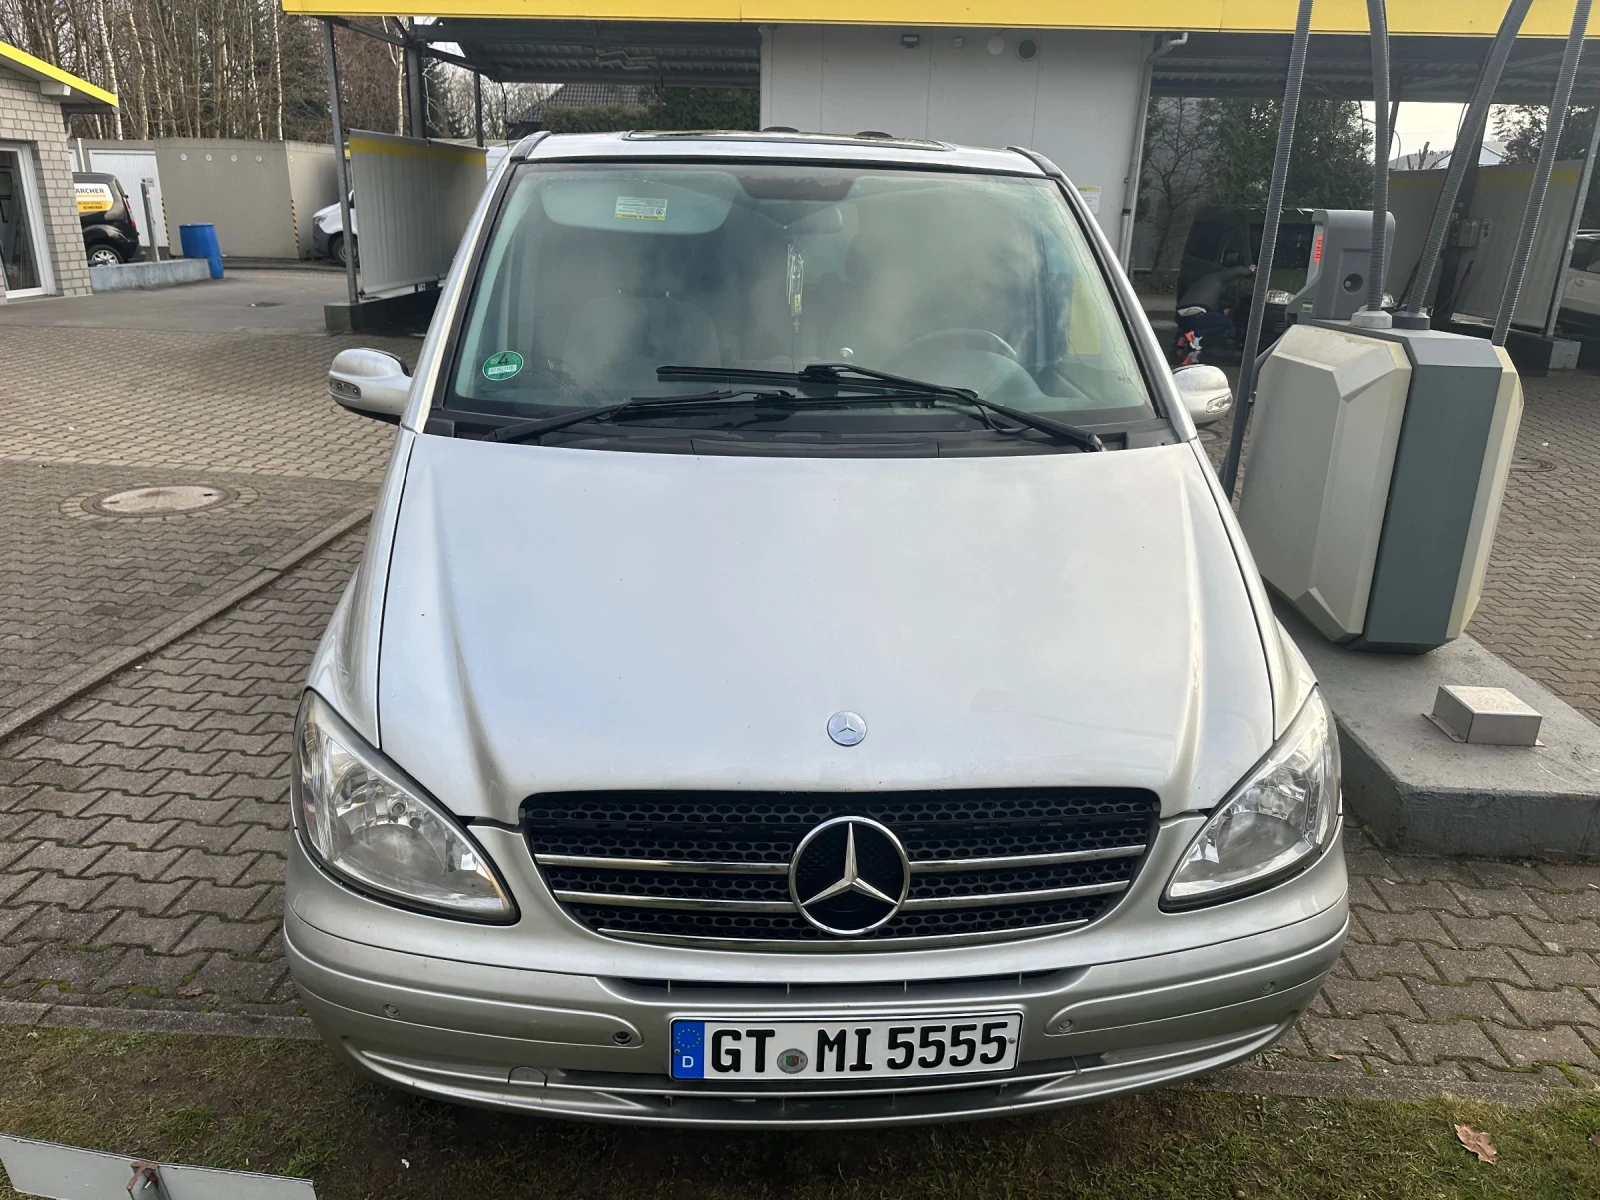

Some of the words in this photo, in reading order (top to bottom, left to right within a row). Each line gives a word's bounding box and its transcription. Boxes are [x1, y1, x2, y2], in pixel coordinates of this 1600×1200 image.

[498, 353, 509, 365] 4
[711, 1028, 775, 1073] GT
[815, 1028, 873, 1073] MI
[886, 1021, 1009, 1070] 5555
[682, 1055, 694, 1068] D
